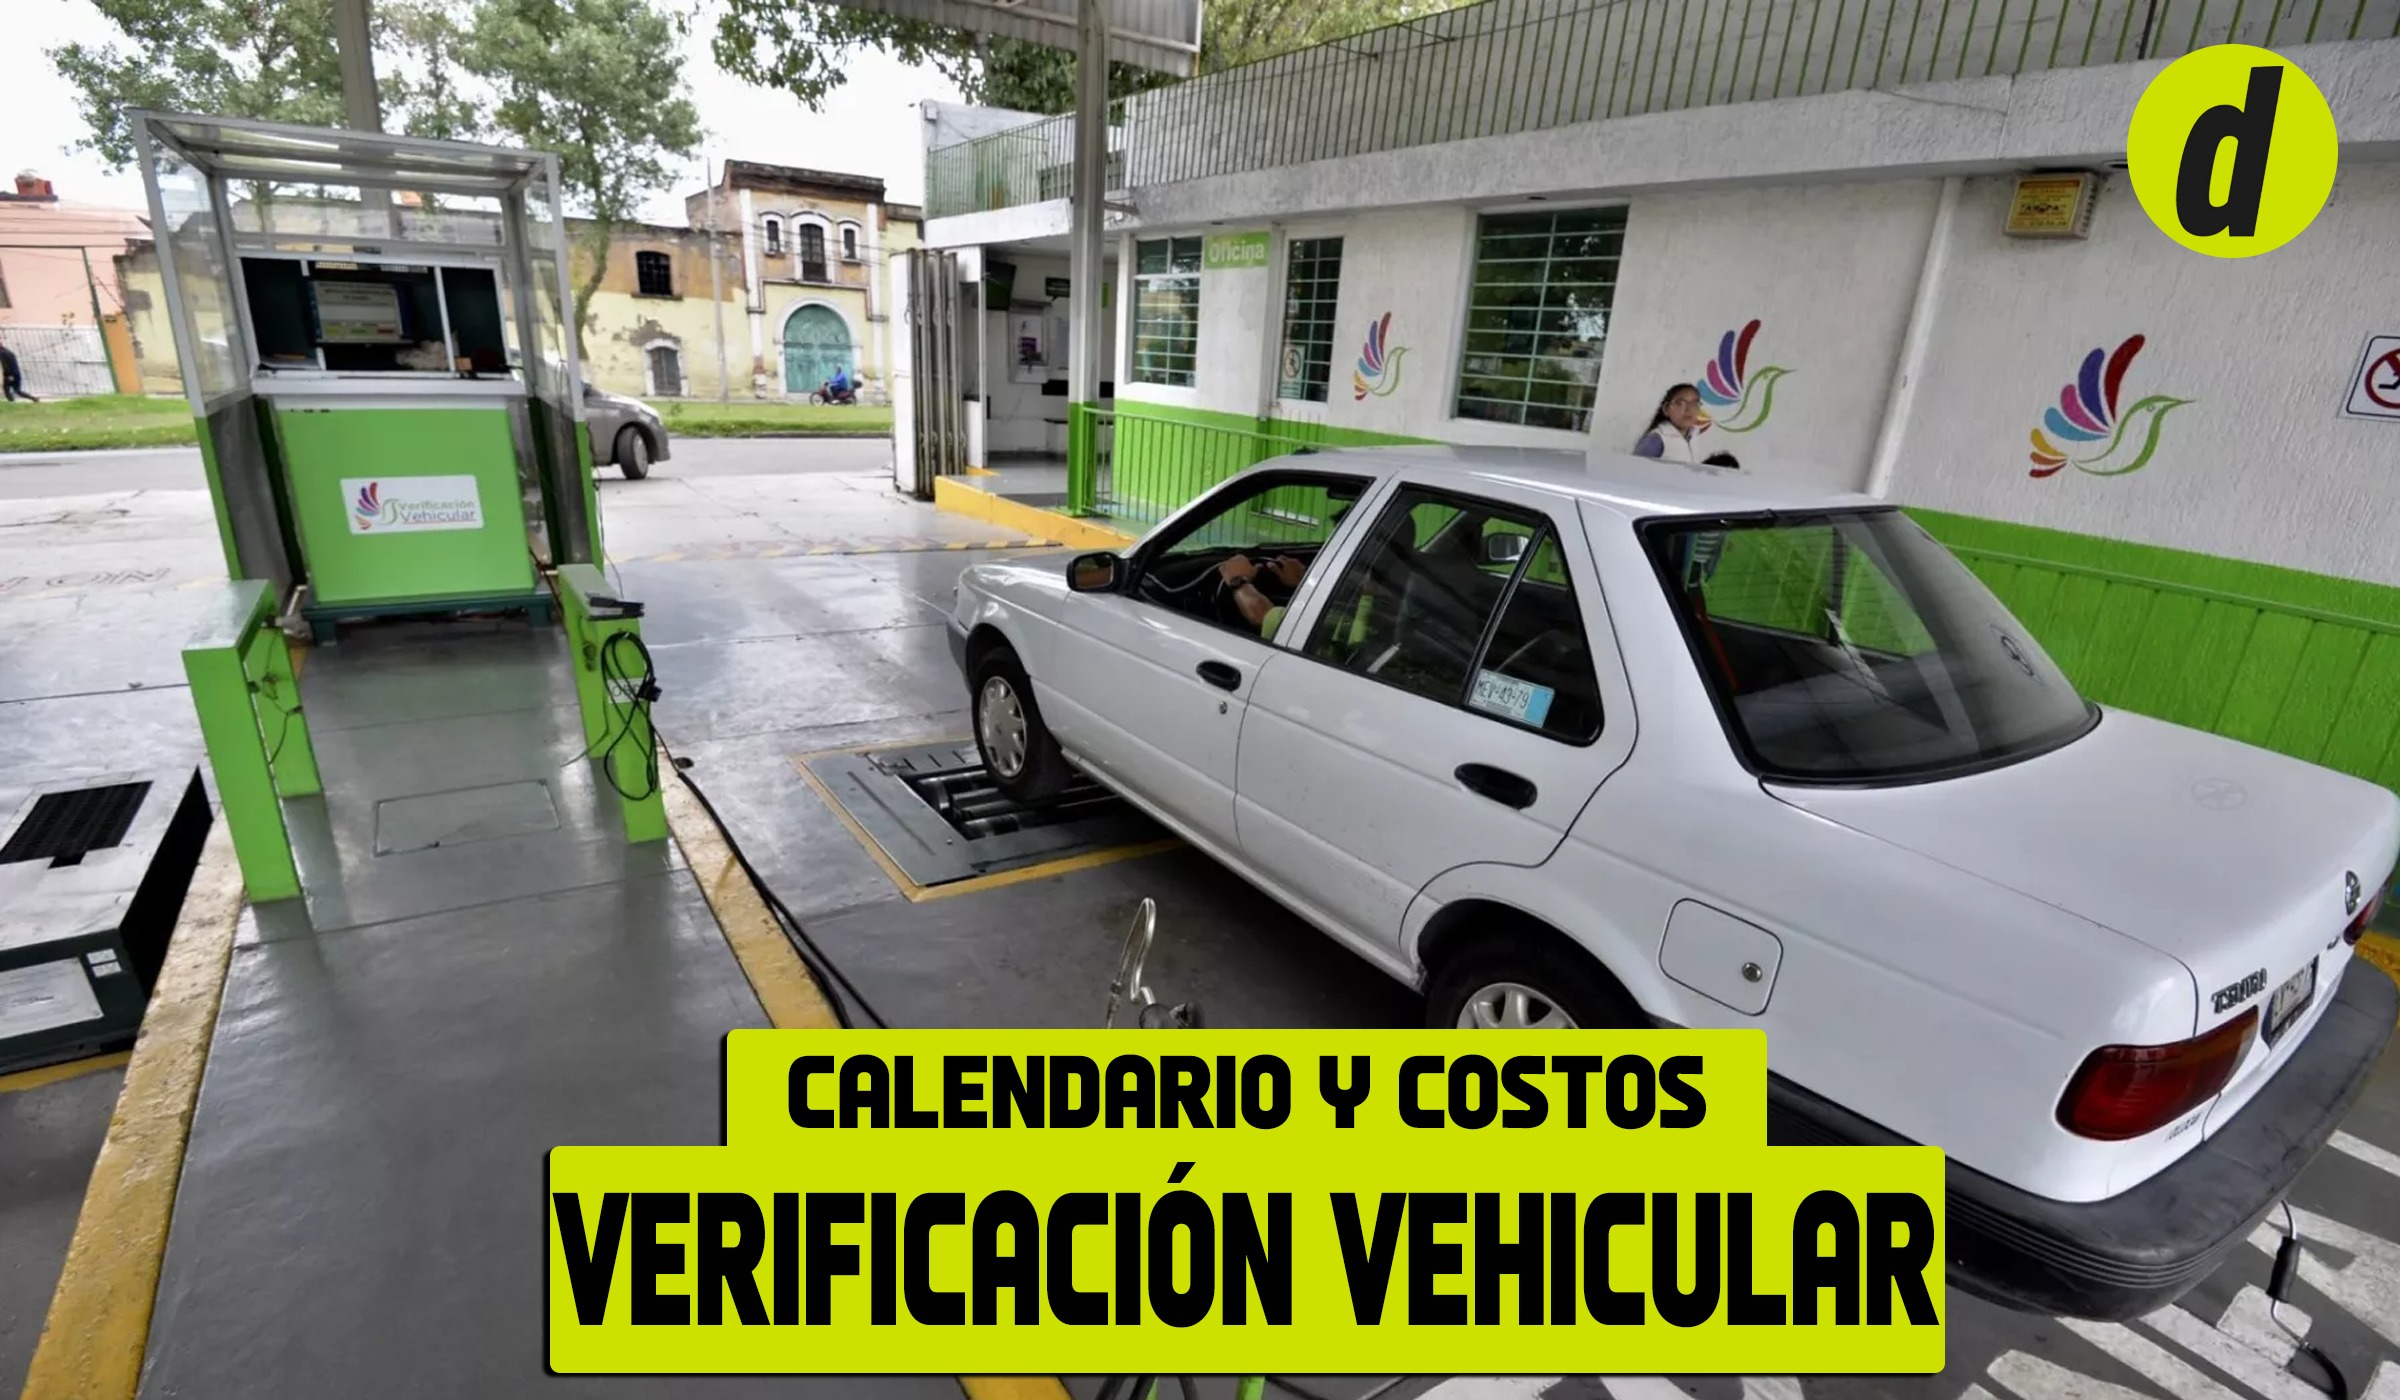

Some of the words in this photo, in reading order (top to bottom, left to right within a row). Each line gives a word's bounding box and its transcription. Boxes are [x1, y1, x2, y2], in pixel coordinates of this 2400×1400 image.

[1209, 239, 1265, 263] Oficina
[399, 500, 475, 511] Verificación
[400, 509, 476, 522] Vehicular
